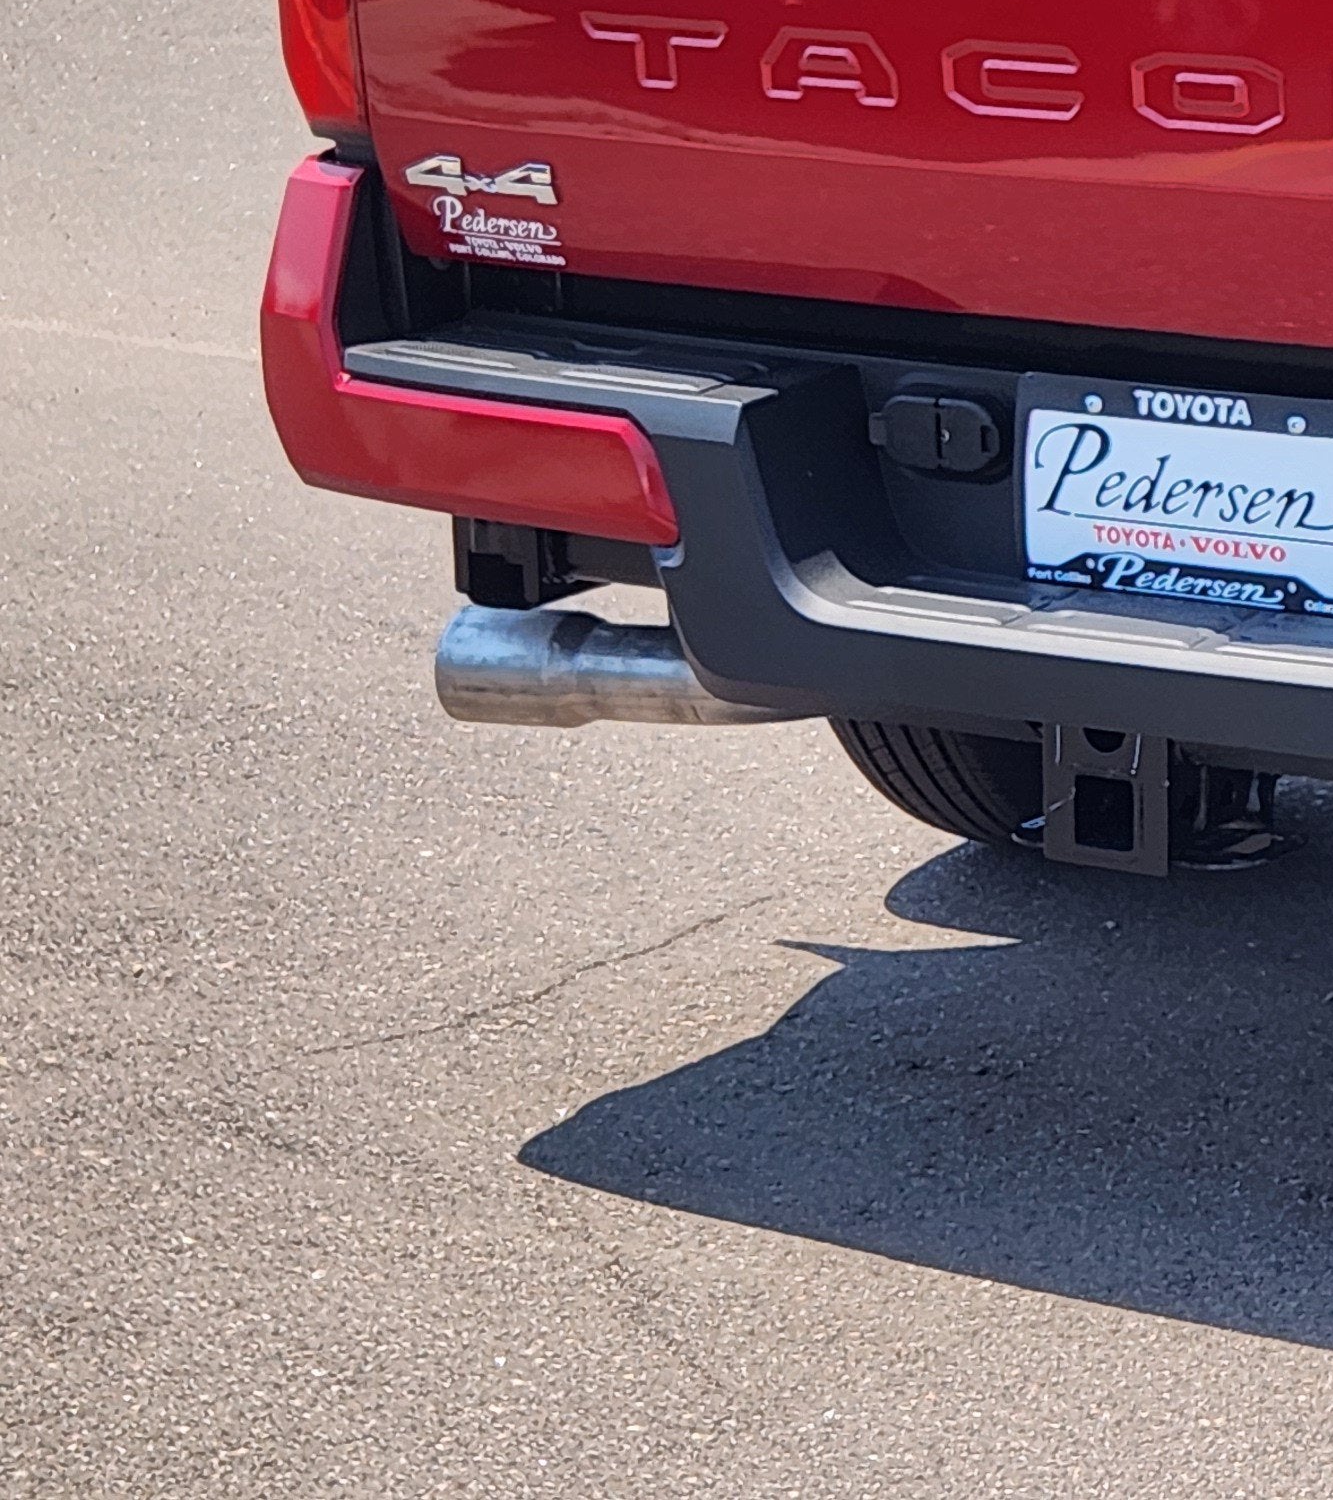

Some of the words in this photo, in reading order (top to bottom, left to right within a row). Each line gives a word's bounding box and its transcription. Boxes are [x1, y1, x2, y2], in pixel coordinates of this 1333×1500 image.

[404, 153, 559, 206] 4x4
[432, 195, 558, 241] Pedersen
[1132, 388, 1253, 428] TOYOTA
[1092, 524, 1176, 552] TOYOTA
[1189, 535, 1288, 564] VOLVO
[1097, 552, 1285, 604] Pedersen
